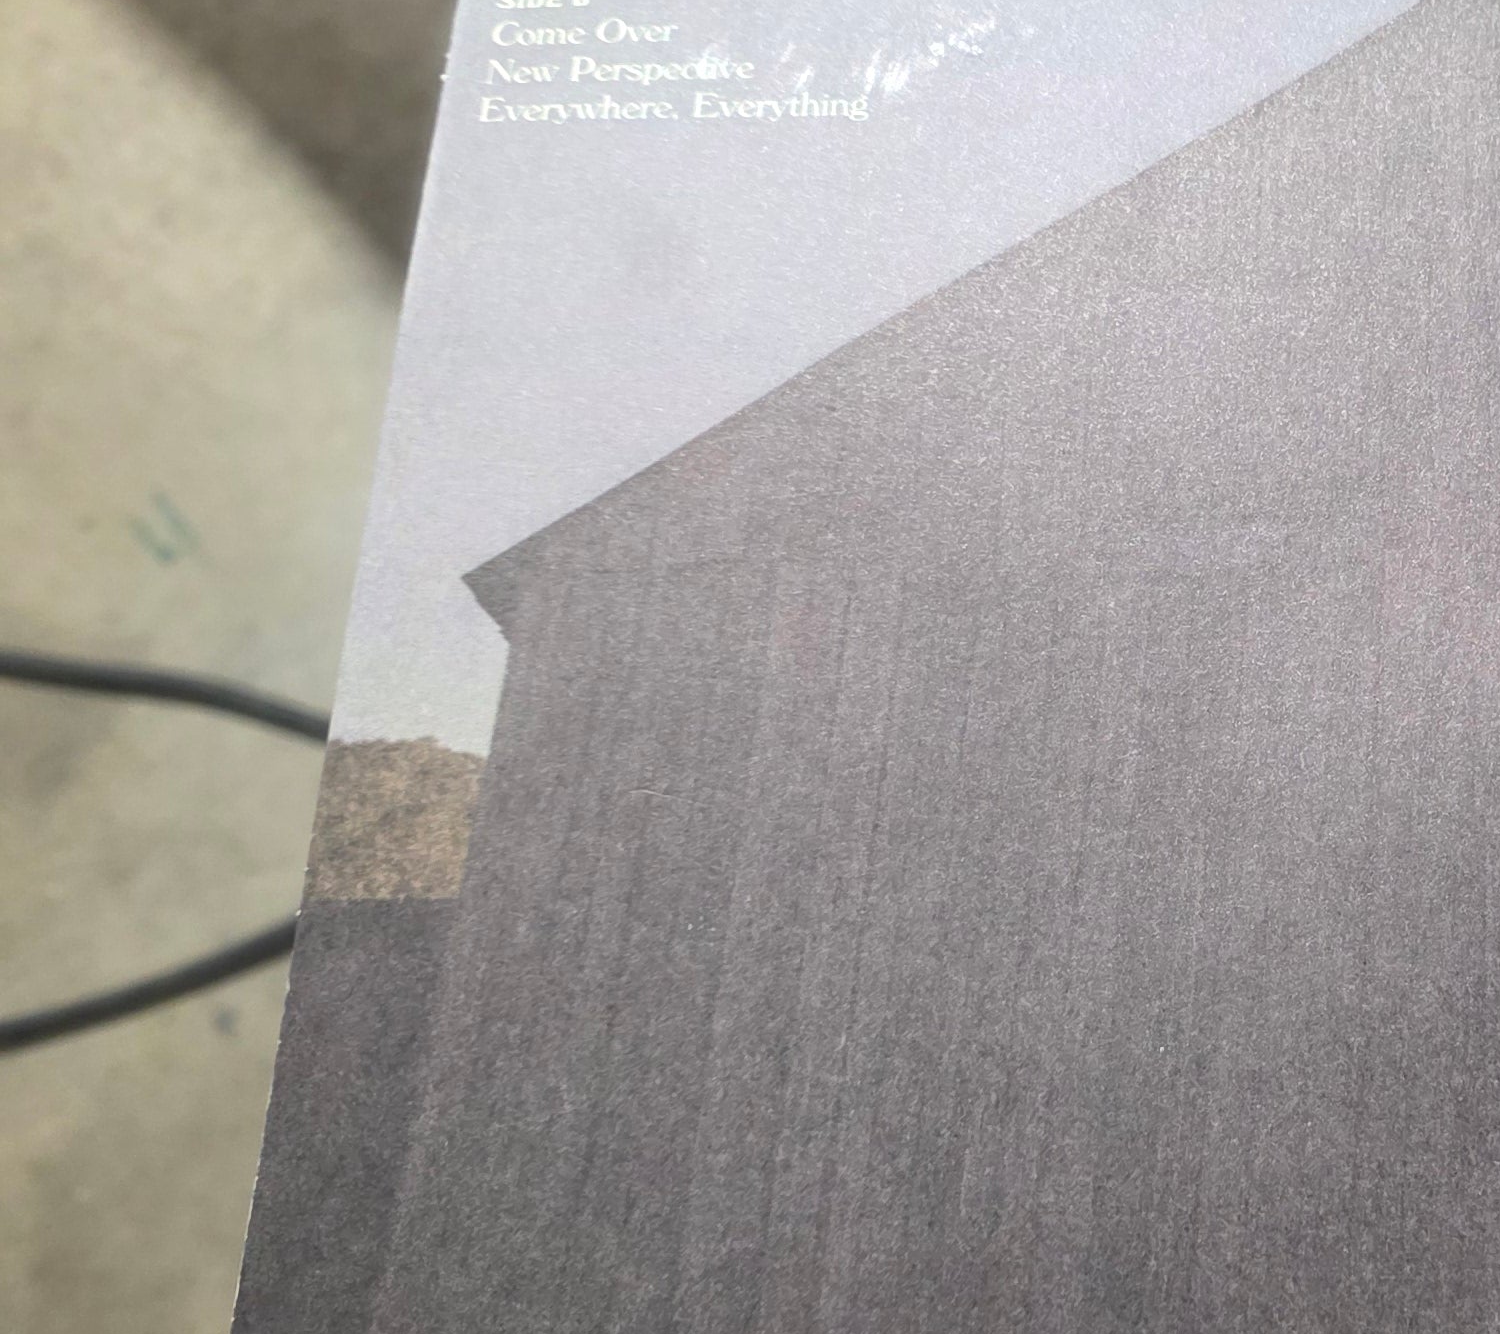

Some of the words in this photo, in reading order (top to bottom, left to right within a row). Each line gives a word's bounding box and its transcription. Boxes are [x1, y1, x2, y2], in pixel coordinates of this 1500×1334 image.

[491, 20, 586, 47] Come
[596, 18, 679, 43] Over
[485, 58, 560, 85] New
[479, 95, 679, 125] Everywhere,
[693, 91, 870, 121] Everything
